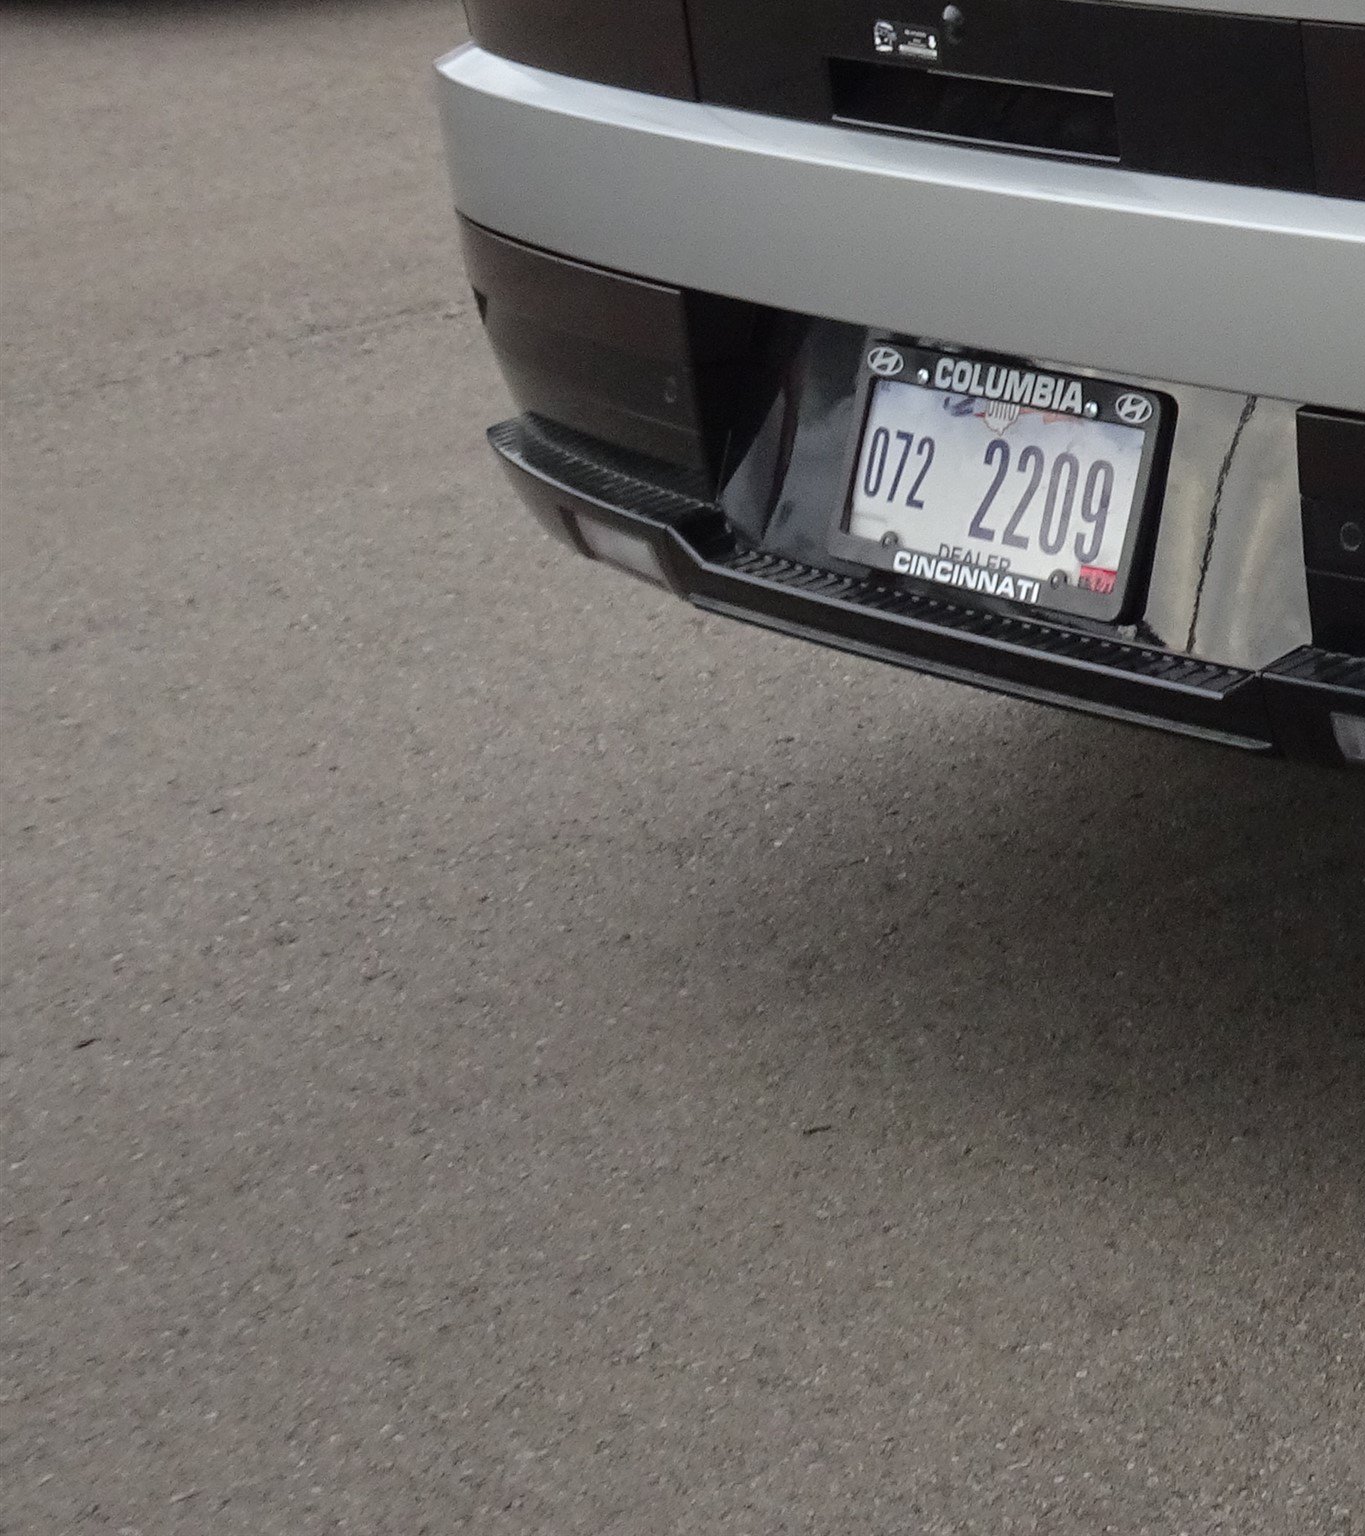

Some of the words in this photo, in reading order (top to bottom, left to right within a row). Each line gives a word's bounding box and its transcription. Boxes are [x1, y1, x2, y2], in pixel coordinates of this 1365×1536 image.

[935, 357, 1086, 414] COLUMBIA
[864, 426, 935, 509] 072
[968, 438, 1115, 564] 2209
[893, 550, 1041, 604] CINCINNATI
